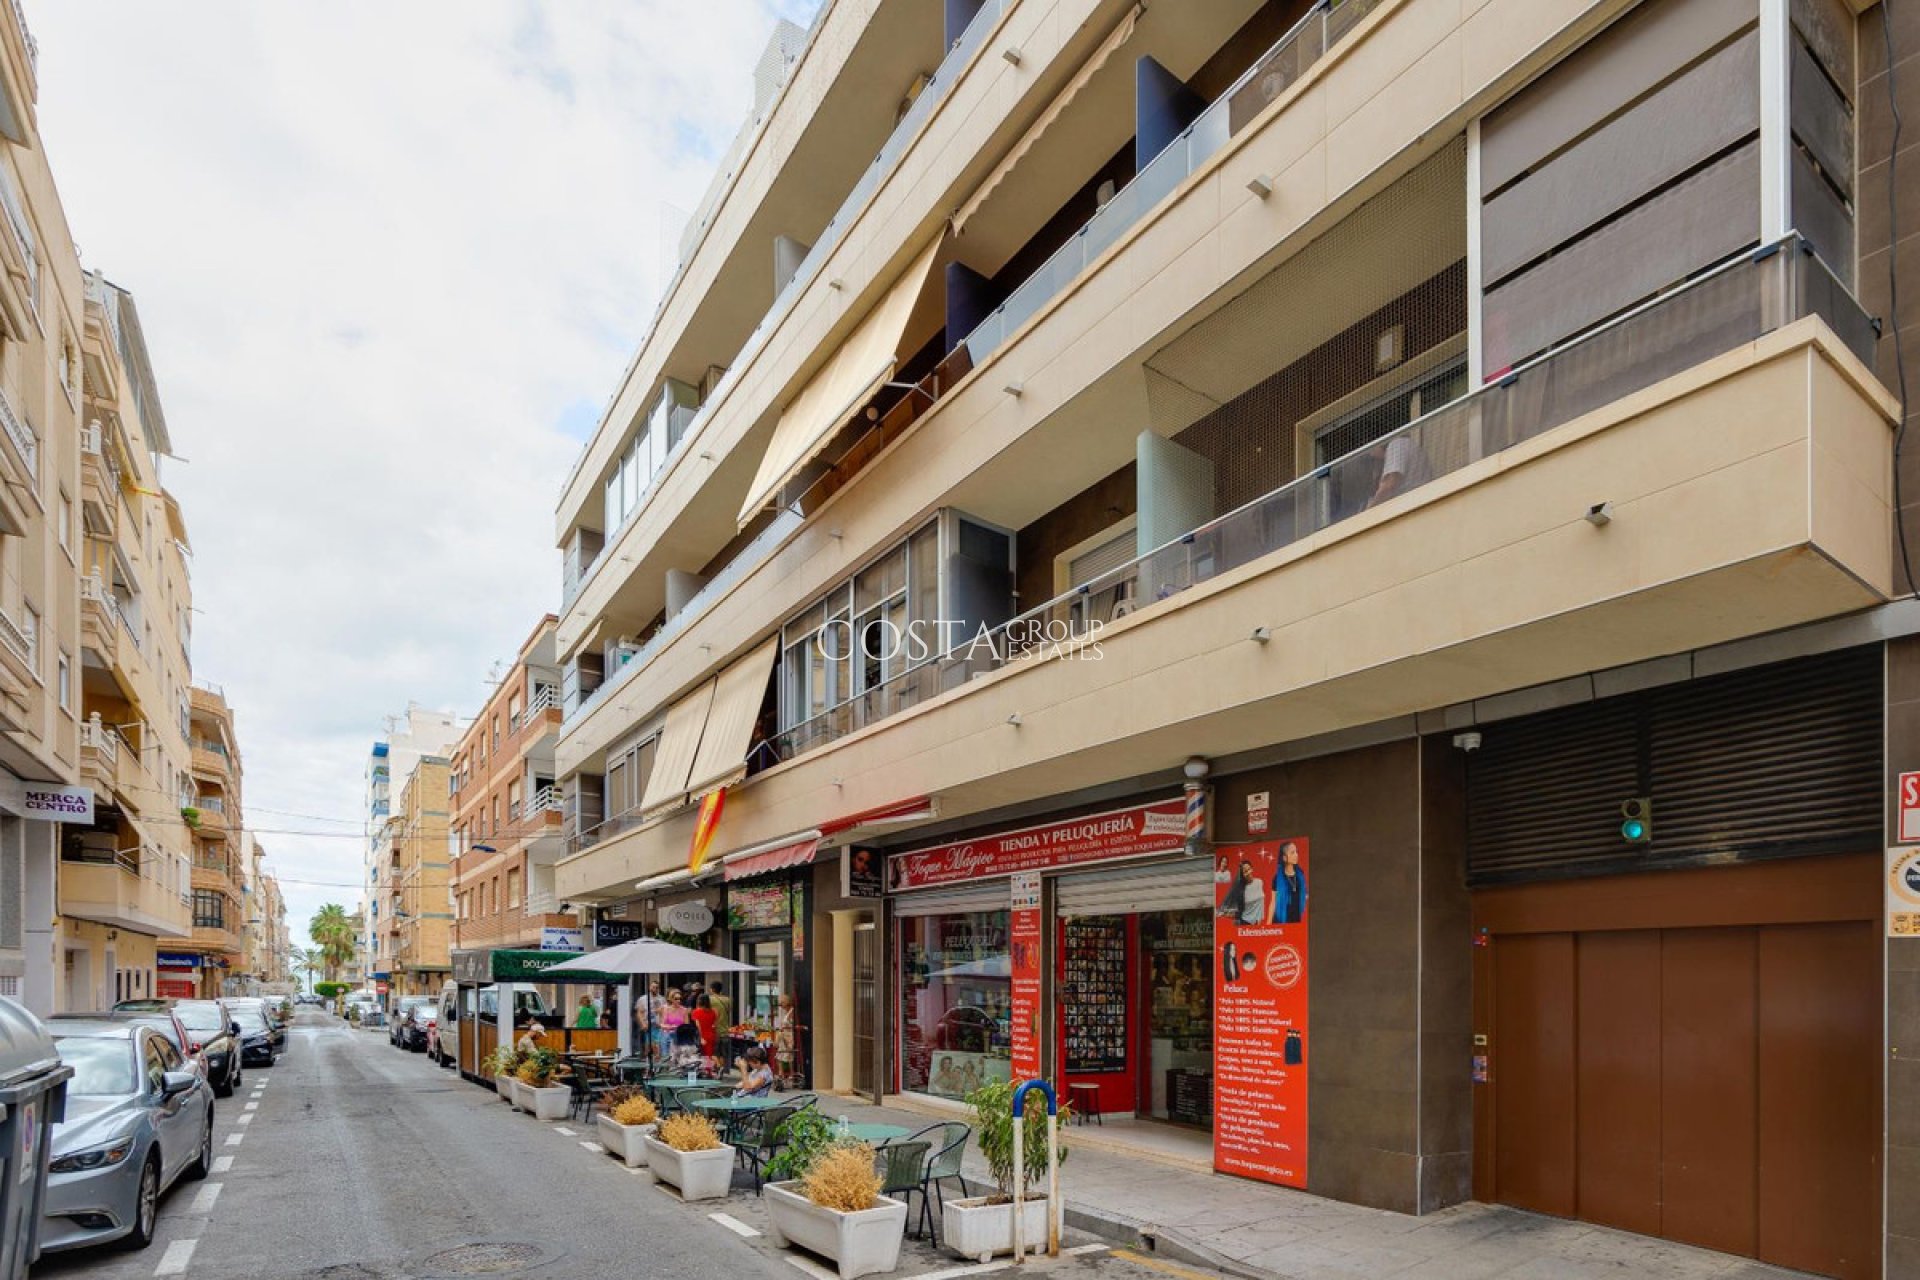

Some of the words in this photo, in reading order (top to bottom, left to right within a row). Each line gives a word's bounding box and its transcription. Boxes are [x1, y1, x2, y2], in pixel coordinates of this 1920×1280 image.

[26, 792, 86, 805] MERCA
[25, 802, 87, 814] CENTRO
[1000, 836, 1040, 852] TIENDA
[1042, 832, 1050, 844] Y
[1052, 815, 1134, 844] PELUQUERÍA
[908, 854, 942, 881] Toque
[944, 845, 994, 874] Mágico
[1238, 927, 1283, 936] Extensiones
[1224, 984, 1248, 992] Peluca
